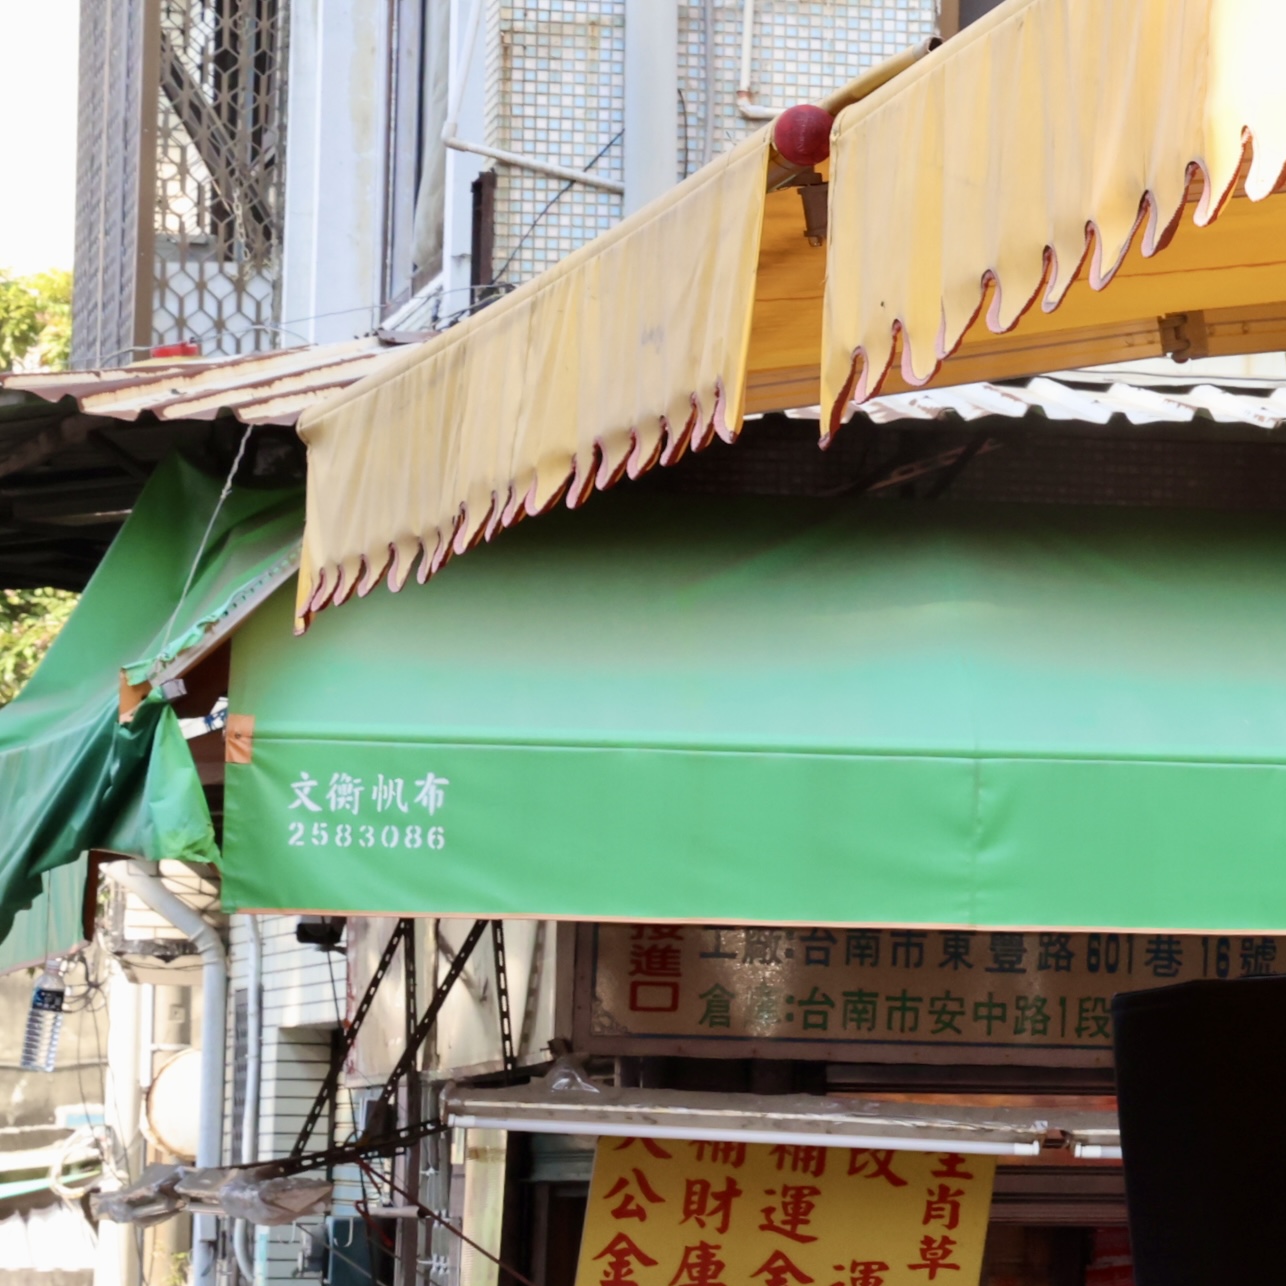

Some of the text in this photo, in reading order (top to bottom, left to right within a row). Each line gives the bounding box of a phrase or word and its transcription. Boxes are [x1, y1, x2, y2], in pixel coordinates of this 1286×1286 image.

[288, 771, 450, 816] 文衡帆布
[288, 821, 446, 850] 2583086
